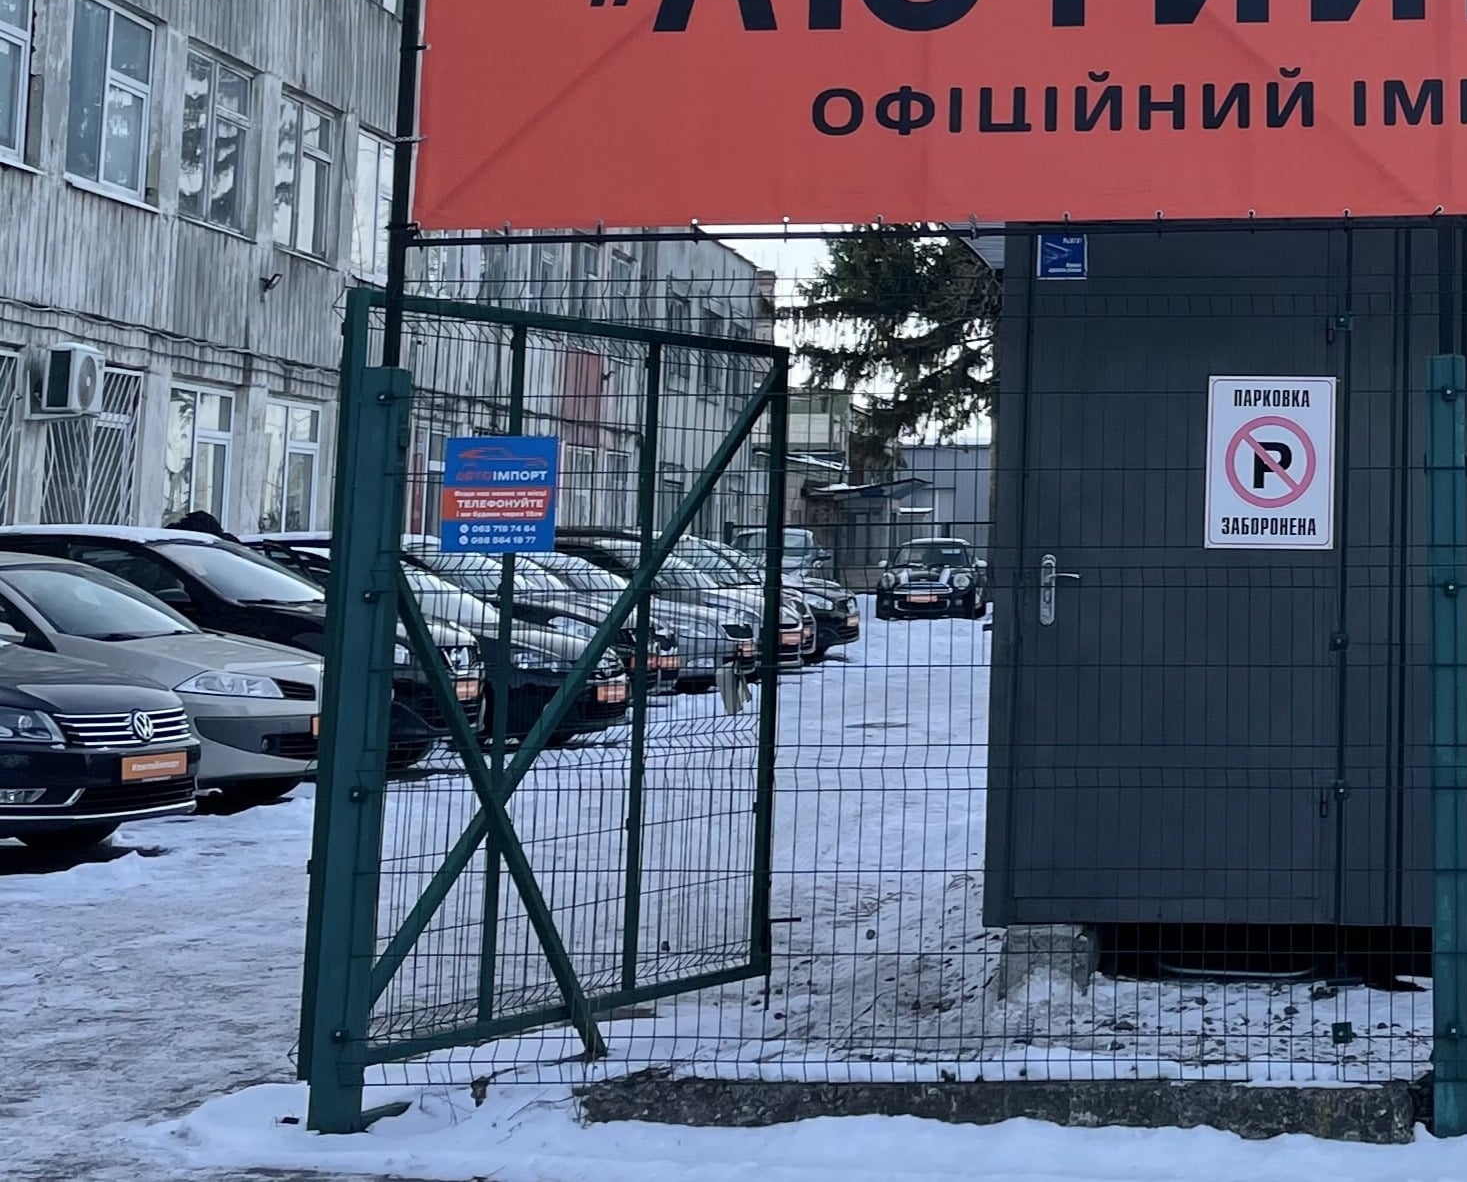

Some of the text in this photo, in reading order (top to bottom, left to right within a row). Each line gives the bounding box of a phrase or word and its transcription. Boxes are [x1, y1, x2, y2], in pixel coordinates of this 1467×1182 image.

[812, 67, 1315, 136] ОФІЦІЙНИЙ
[1233, 389, 1310, 407] ПАРКОВКА
[456, 498, 544, 509] ТЕЛЕФОНУЙТЕ
[1221, 517, 1316, 536] ЗАБОРОНЕНА
